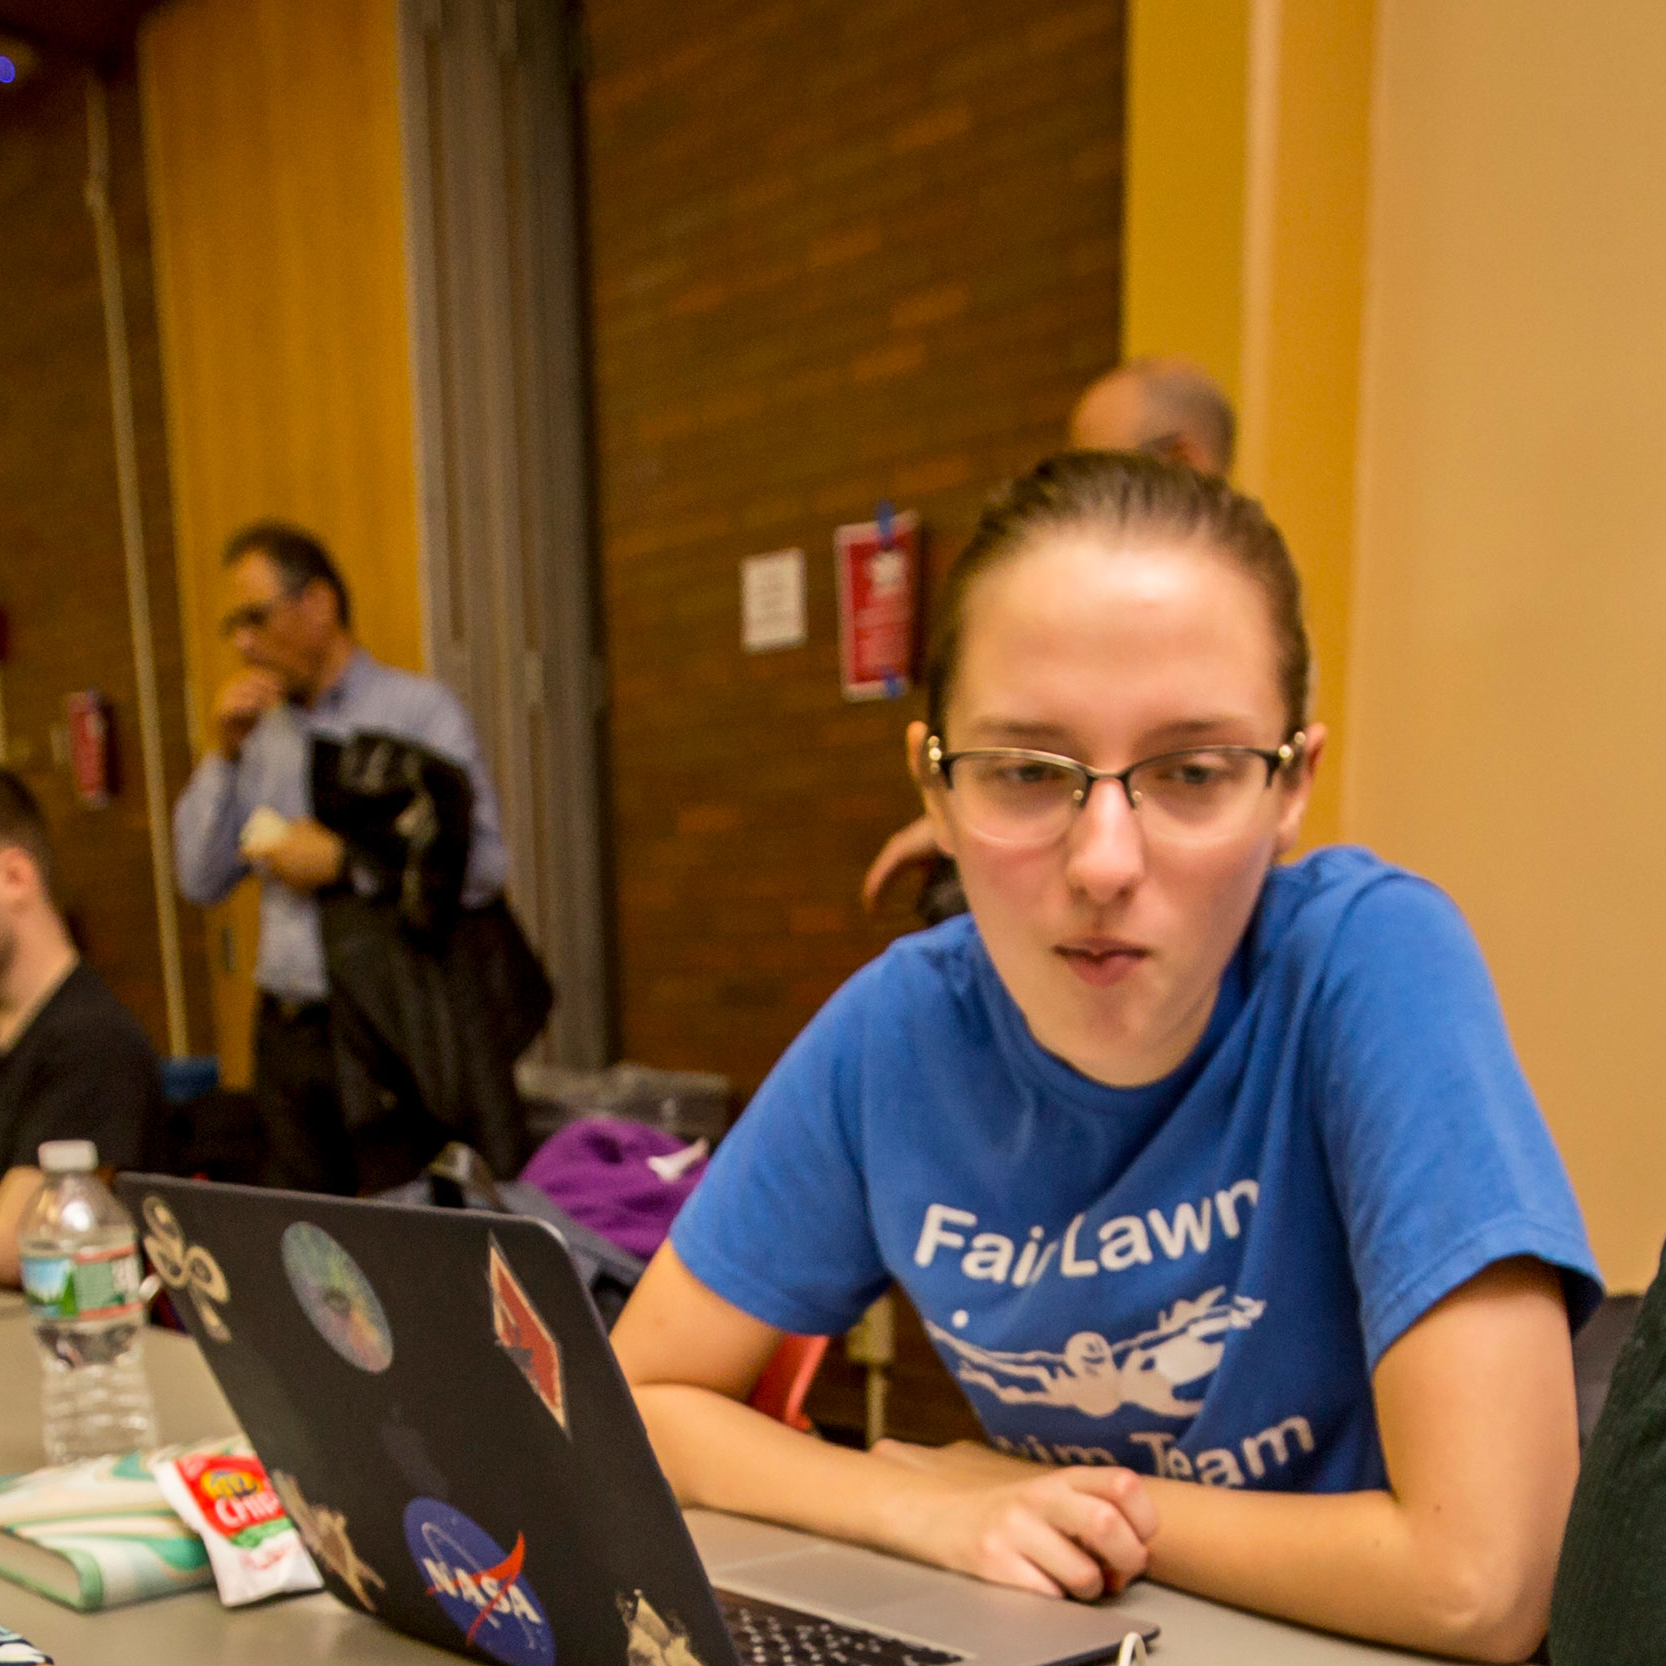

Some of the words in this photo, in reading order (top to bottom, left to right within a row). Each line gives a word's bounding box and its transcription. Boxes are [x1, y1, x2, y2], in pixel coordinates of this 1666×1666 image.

[914, 1203, 1059, 1288] Fair
[1059, 1179, 1261, 1278] Lawn
[1130, 1415, 1315, 1488] Team
[422, 1558, 542, 1624] NASA
